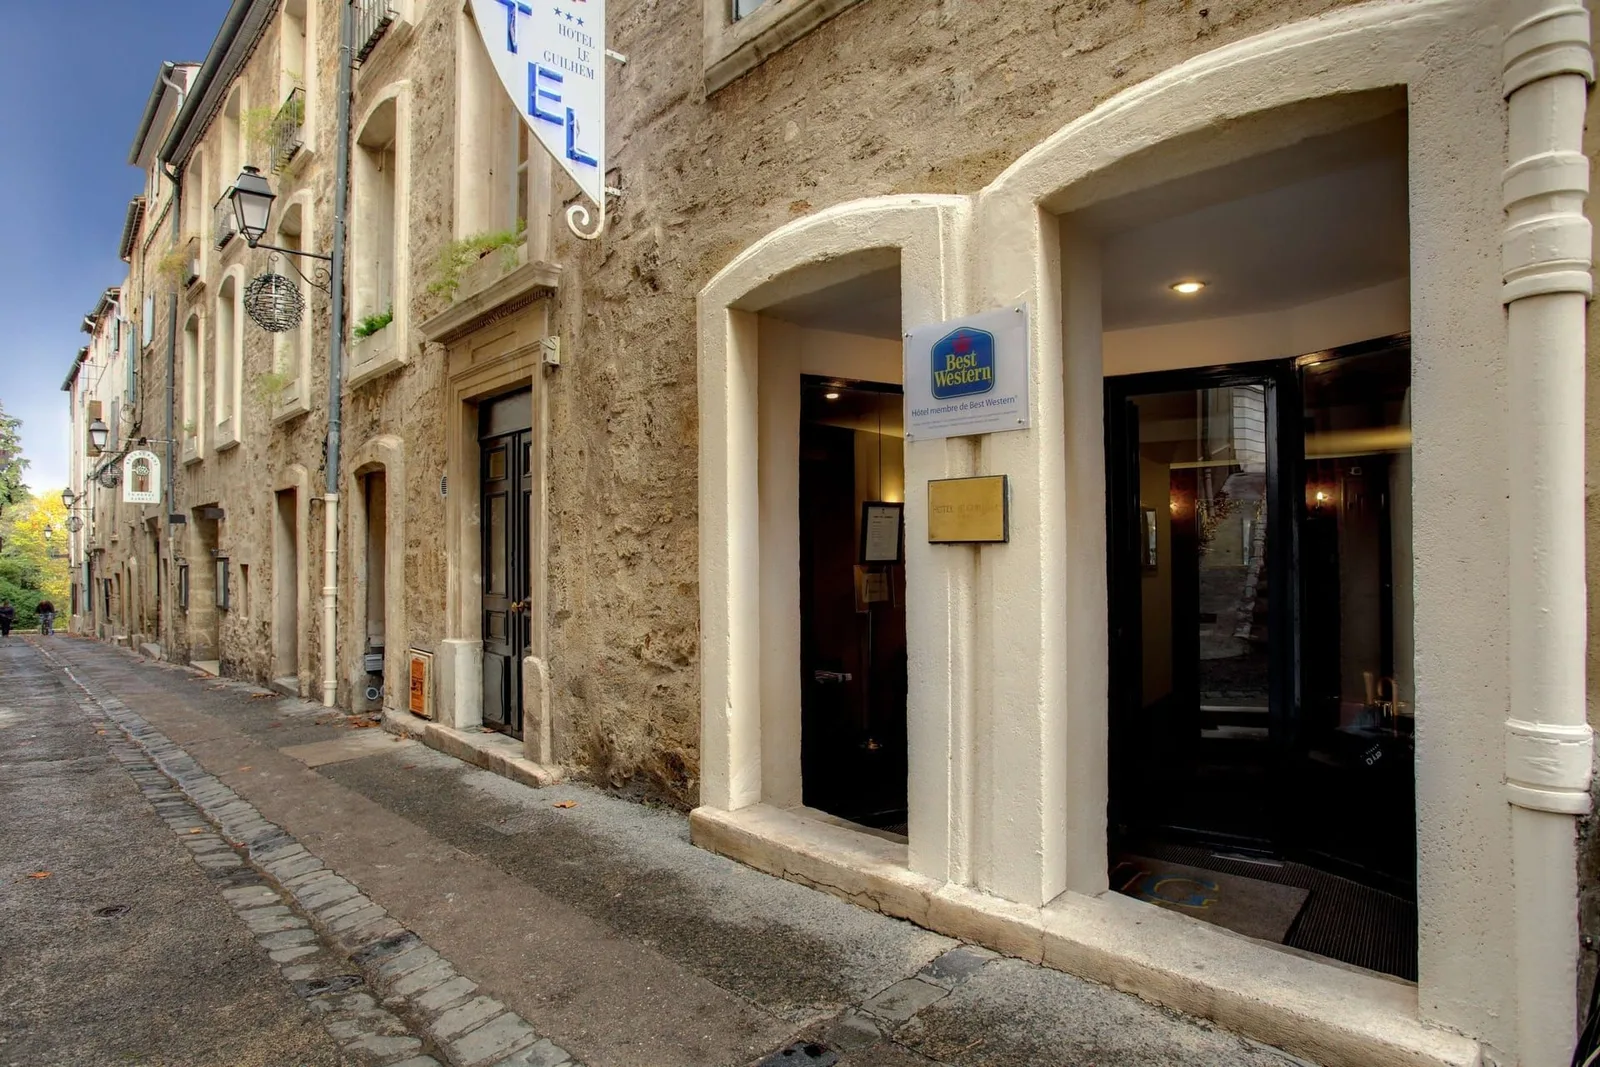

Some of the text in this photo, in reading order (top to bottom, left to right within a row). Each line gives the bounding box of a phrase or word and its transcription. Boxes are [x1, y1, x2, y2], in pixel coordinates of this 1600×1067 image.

[558, 23, 595, 49] HOTEL
[543, 50, 595, 80] GUILHEM
[577, 46, 590, 63] LE
[945, 350, 978, 373] Best
[934, 364, 992, 388] Western
[911, 407, 929, 417] Hôtel
[930, 404, 959, 415] membre
[959, 402, 968, 411] de
[969, 400, 984, 410] Best
